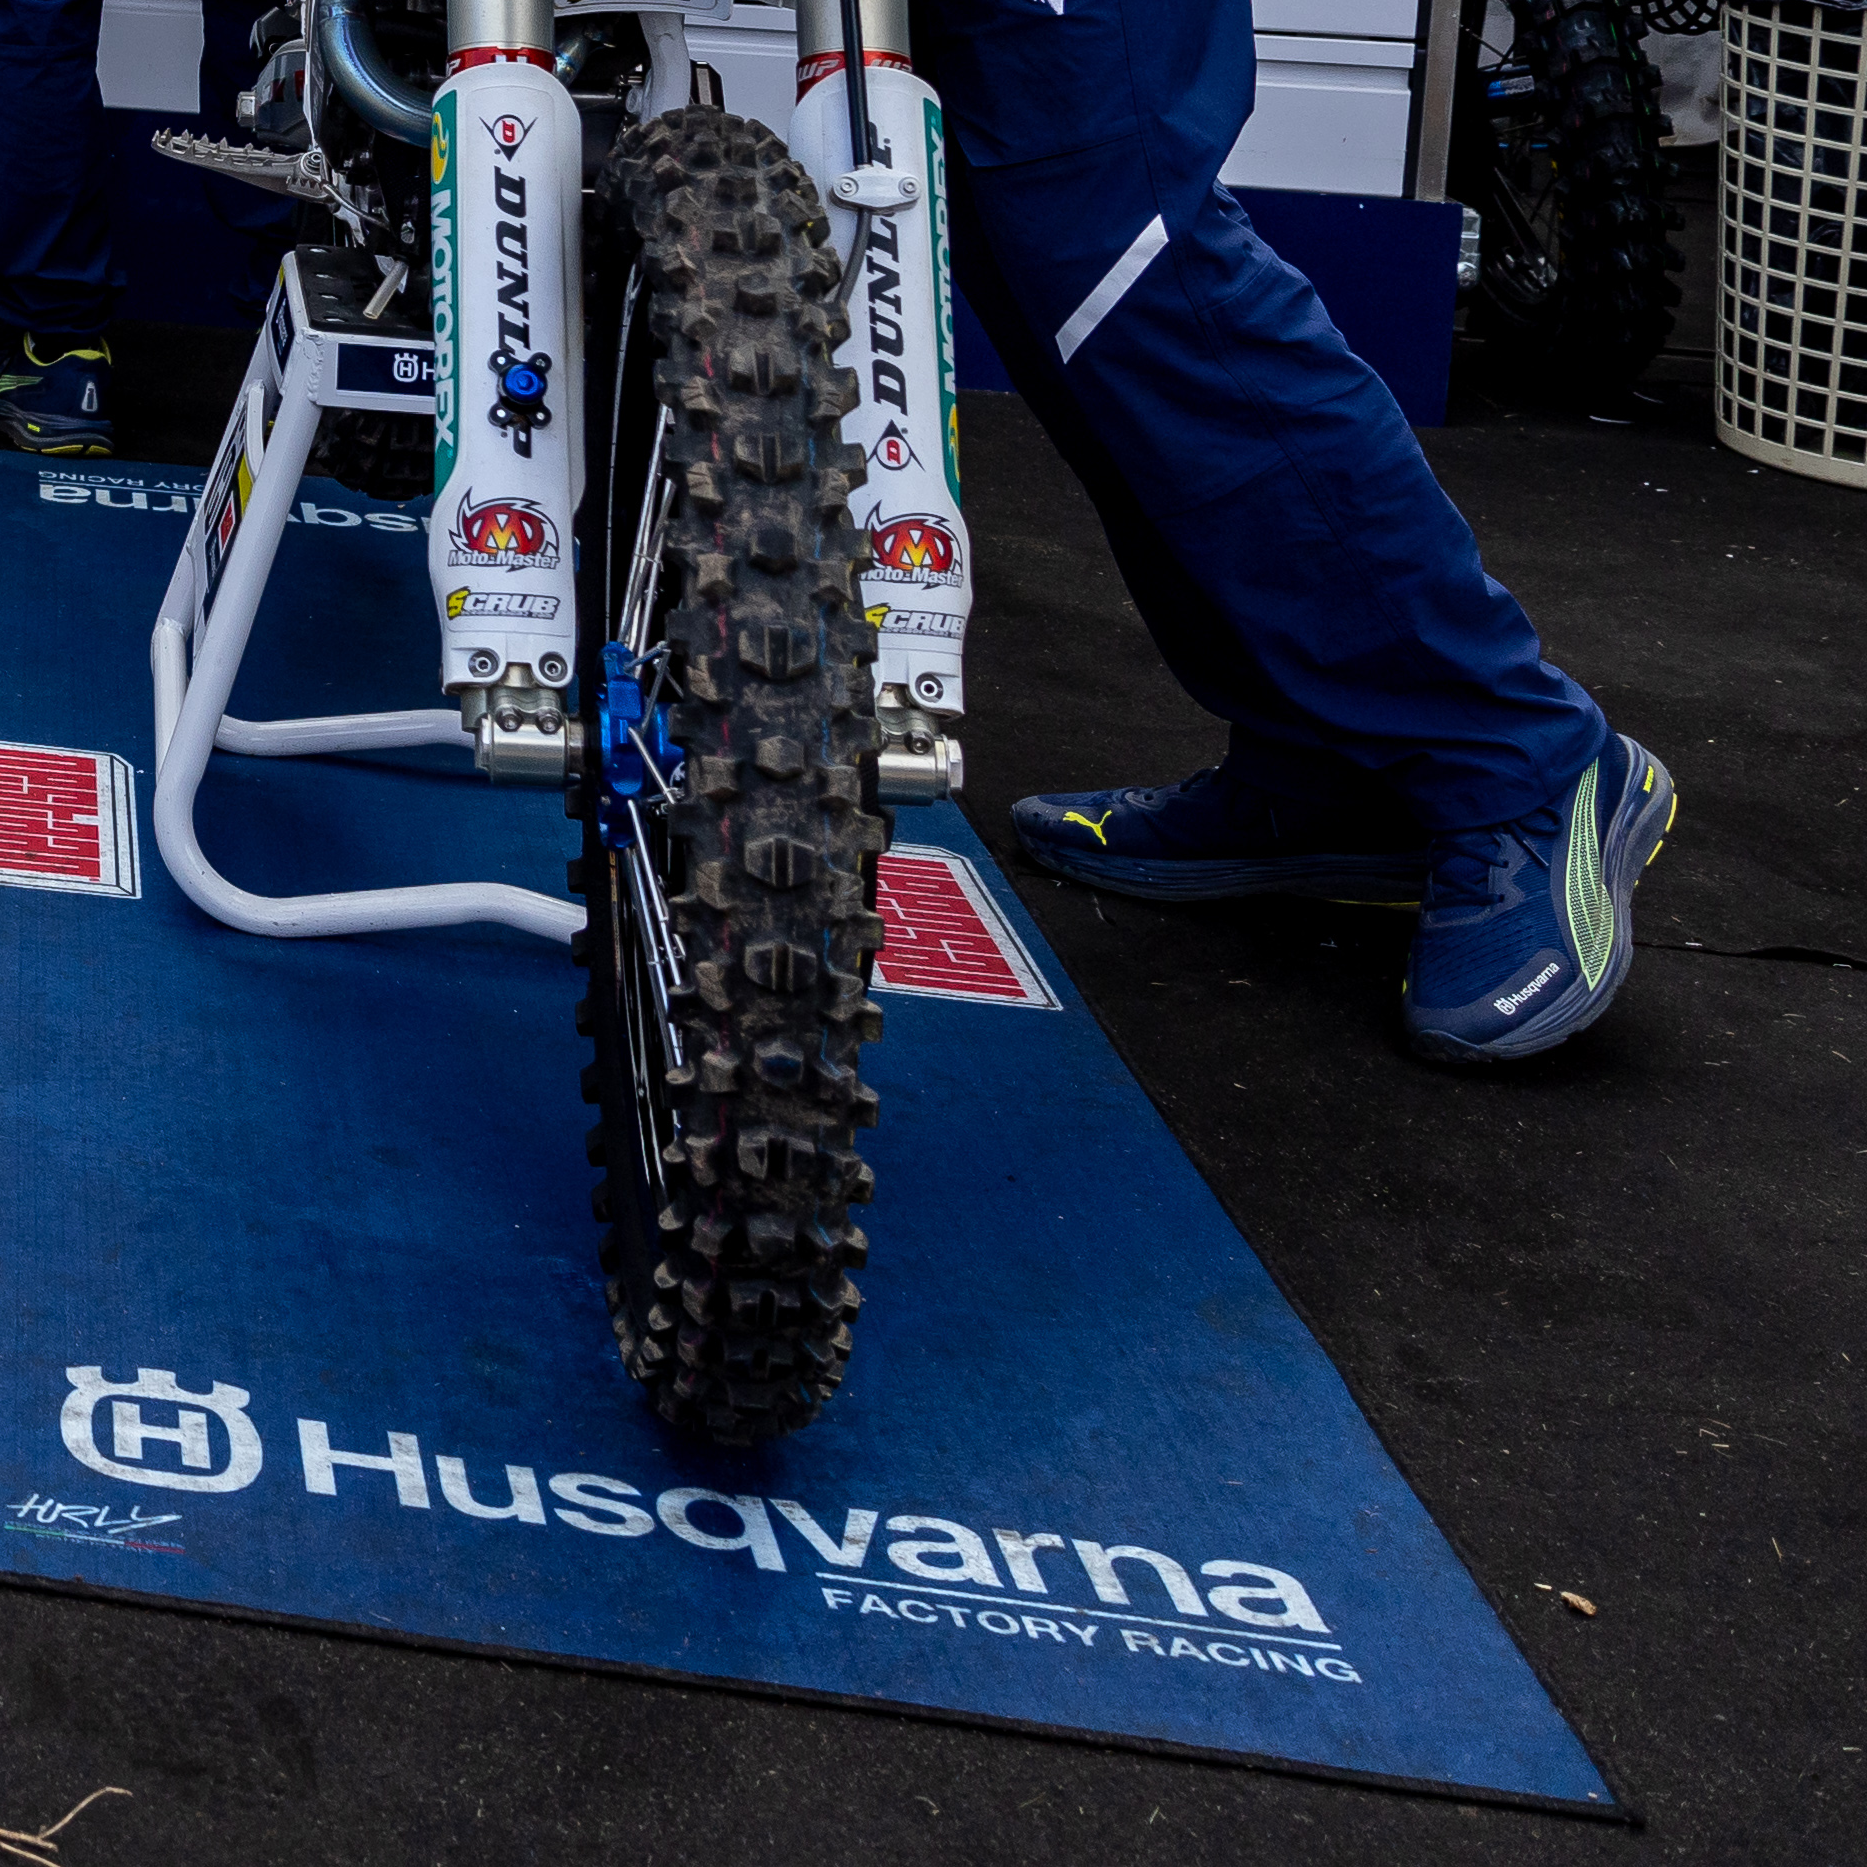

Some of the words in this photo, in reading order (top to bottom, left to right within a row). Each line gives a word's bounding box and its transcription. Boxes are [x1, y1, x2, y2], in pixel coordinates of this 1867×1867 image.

[430, 188, 455, 459] MOTOREX
[494, 165, 533, 460] DUNLP
[865, 121, 909, 417] DUNLP
[446, 586, 560, 621] SCRUB
[1511, 960, 1560, 1007] Husqvarna
[296, 1416, 1334, 1635] Husqvarna
[819, 1586, 1100, 1649] FACTORY
[1120, 1632, 1364, 1685] RACING
